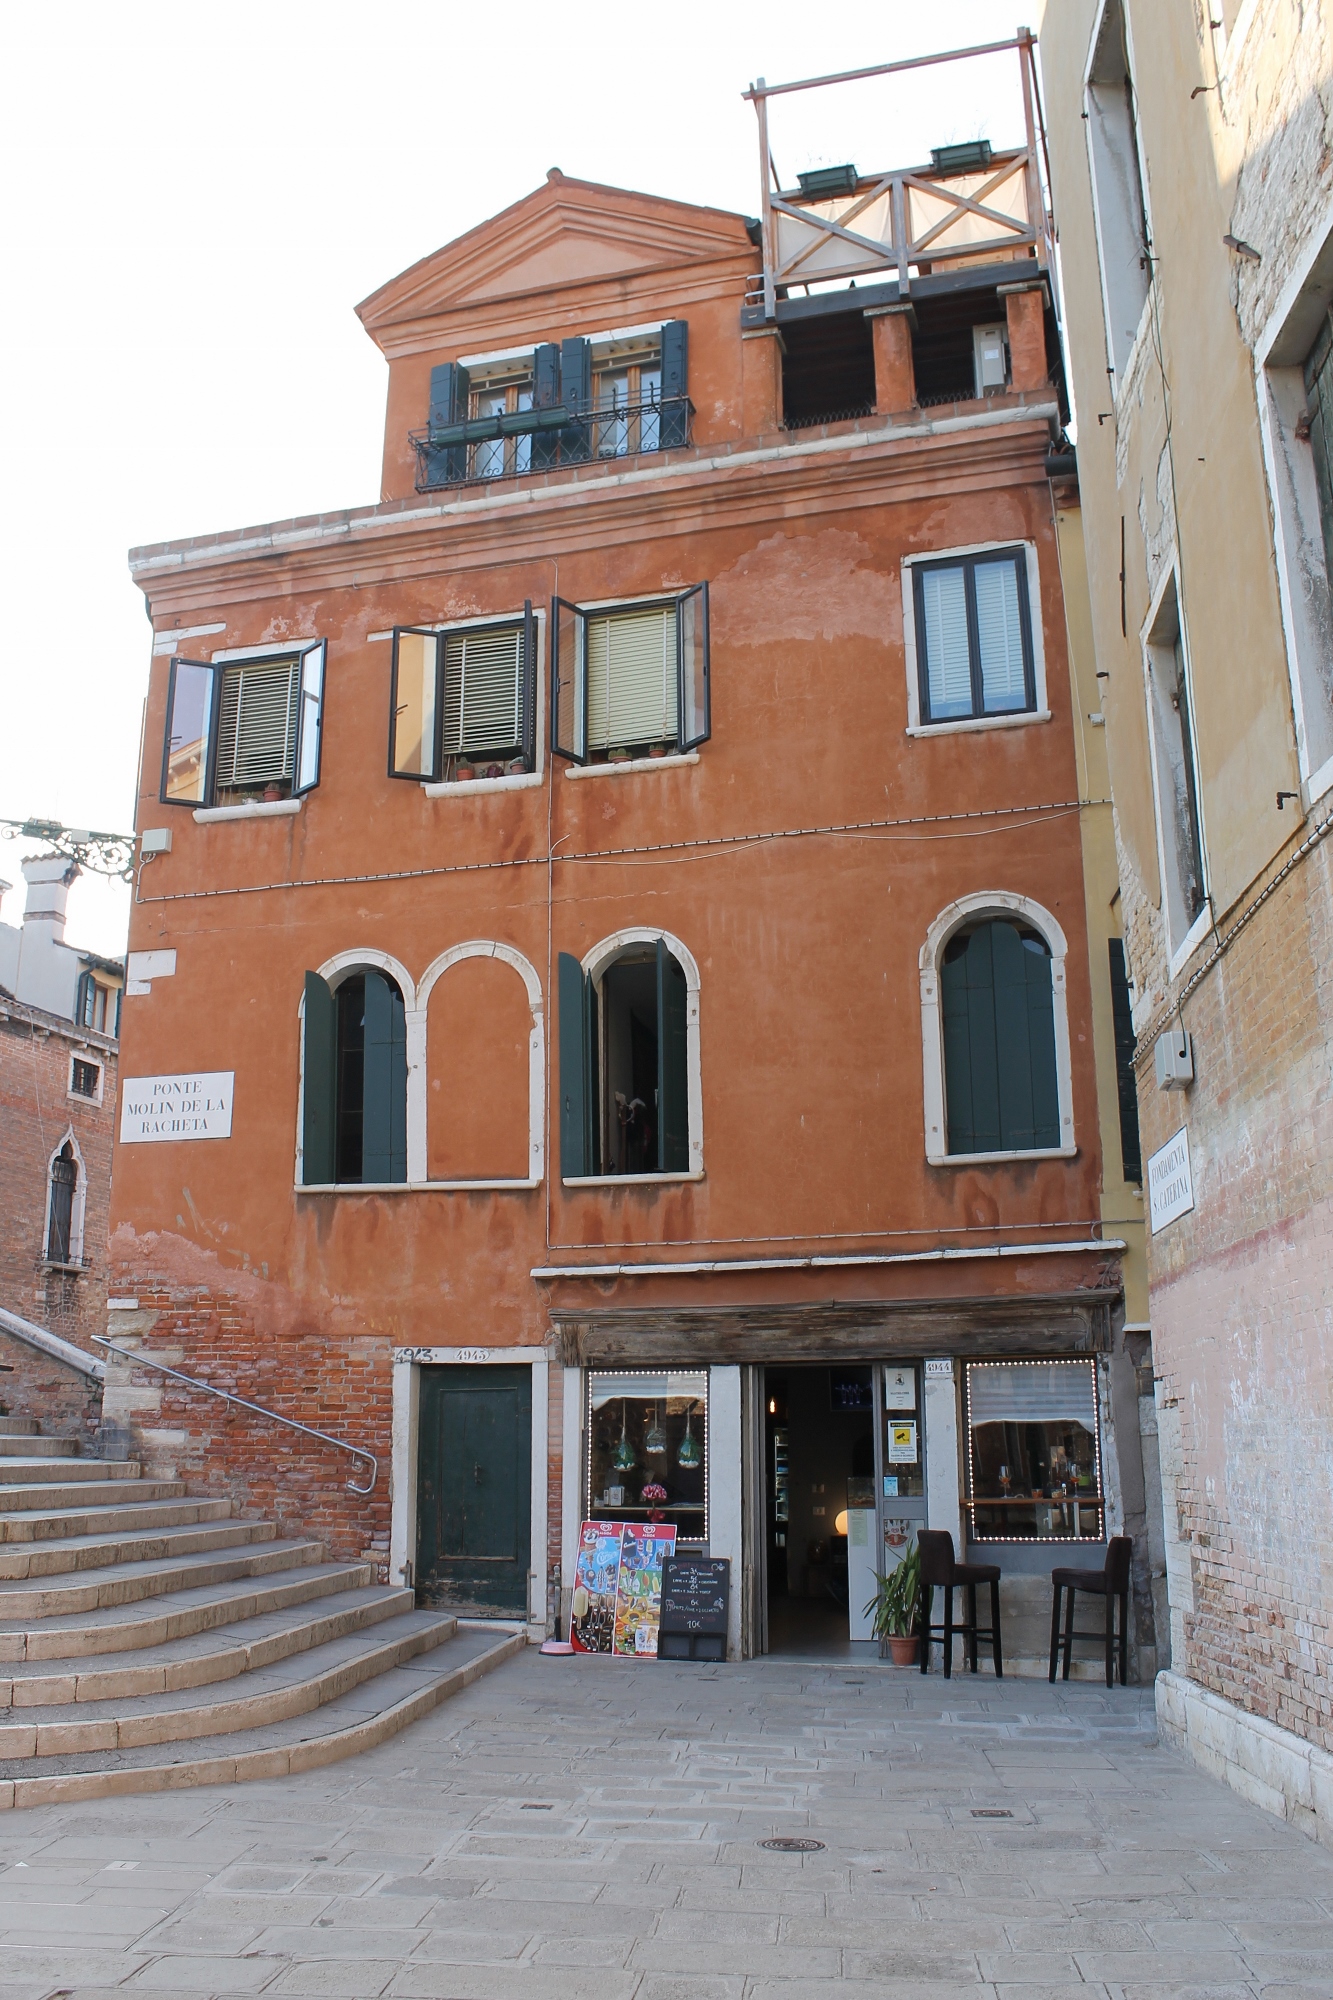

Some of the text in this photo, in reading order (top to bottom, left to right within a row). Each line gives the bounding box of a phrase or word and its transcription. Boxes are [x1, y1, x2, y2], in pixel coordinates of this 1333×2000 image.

[153, 1081, 202, 1096] PONTE
[127, 1098, 225, 1116] MOLIN DE LA
[141, 1118, 208, 1134] RACHETA
[1151, 1143, 1185, 1187] FONDAMENTA
[1159, 1174, 1189, 1211] CATERINA
[927, 1362, 950, 1372] 4944
